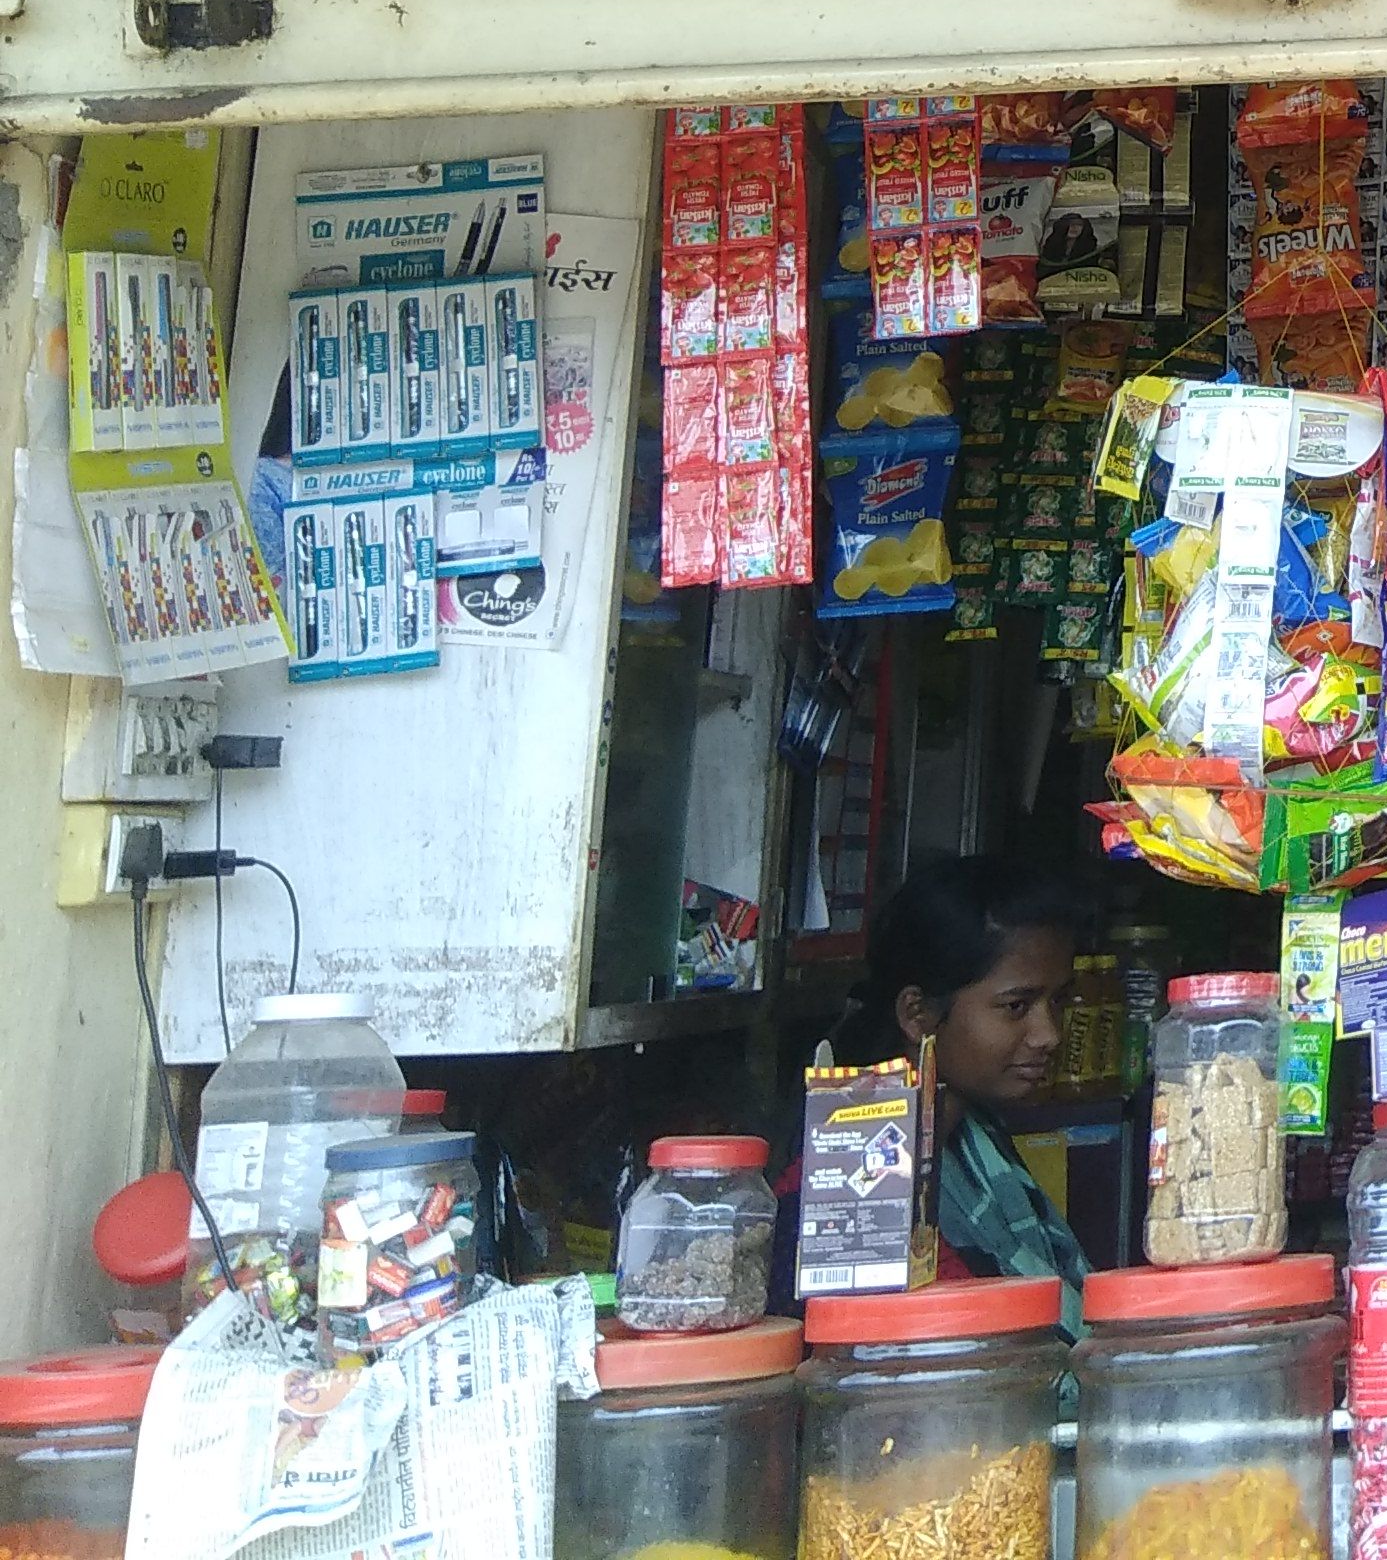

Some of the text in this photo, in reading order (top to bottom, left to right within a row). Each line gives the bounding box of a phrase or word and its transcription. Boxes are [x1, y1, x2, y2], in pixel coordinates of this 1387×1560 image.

[1065, 167, 1106, 182] Nisha
[345, 212, 451, 241] HAUSER
[391, 235, 446, 247] Germany
[1258, 224, 1356, 263] Wheels
[370, 259, 434, 281] cyclone
[1065, 271, 1107, 283] Nisha
[856, 340, 928, 356] Plain Salted
[317, 462, 487, 490] HAUSER cyclone
[866, 473, 924, 494] Diamond
[857, 508, 926, 525] Plain Salted
[464, 591, 537, 618] Ching's
[1340, 925, 1367, 939] Choco
